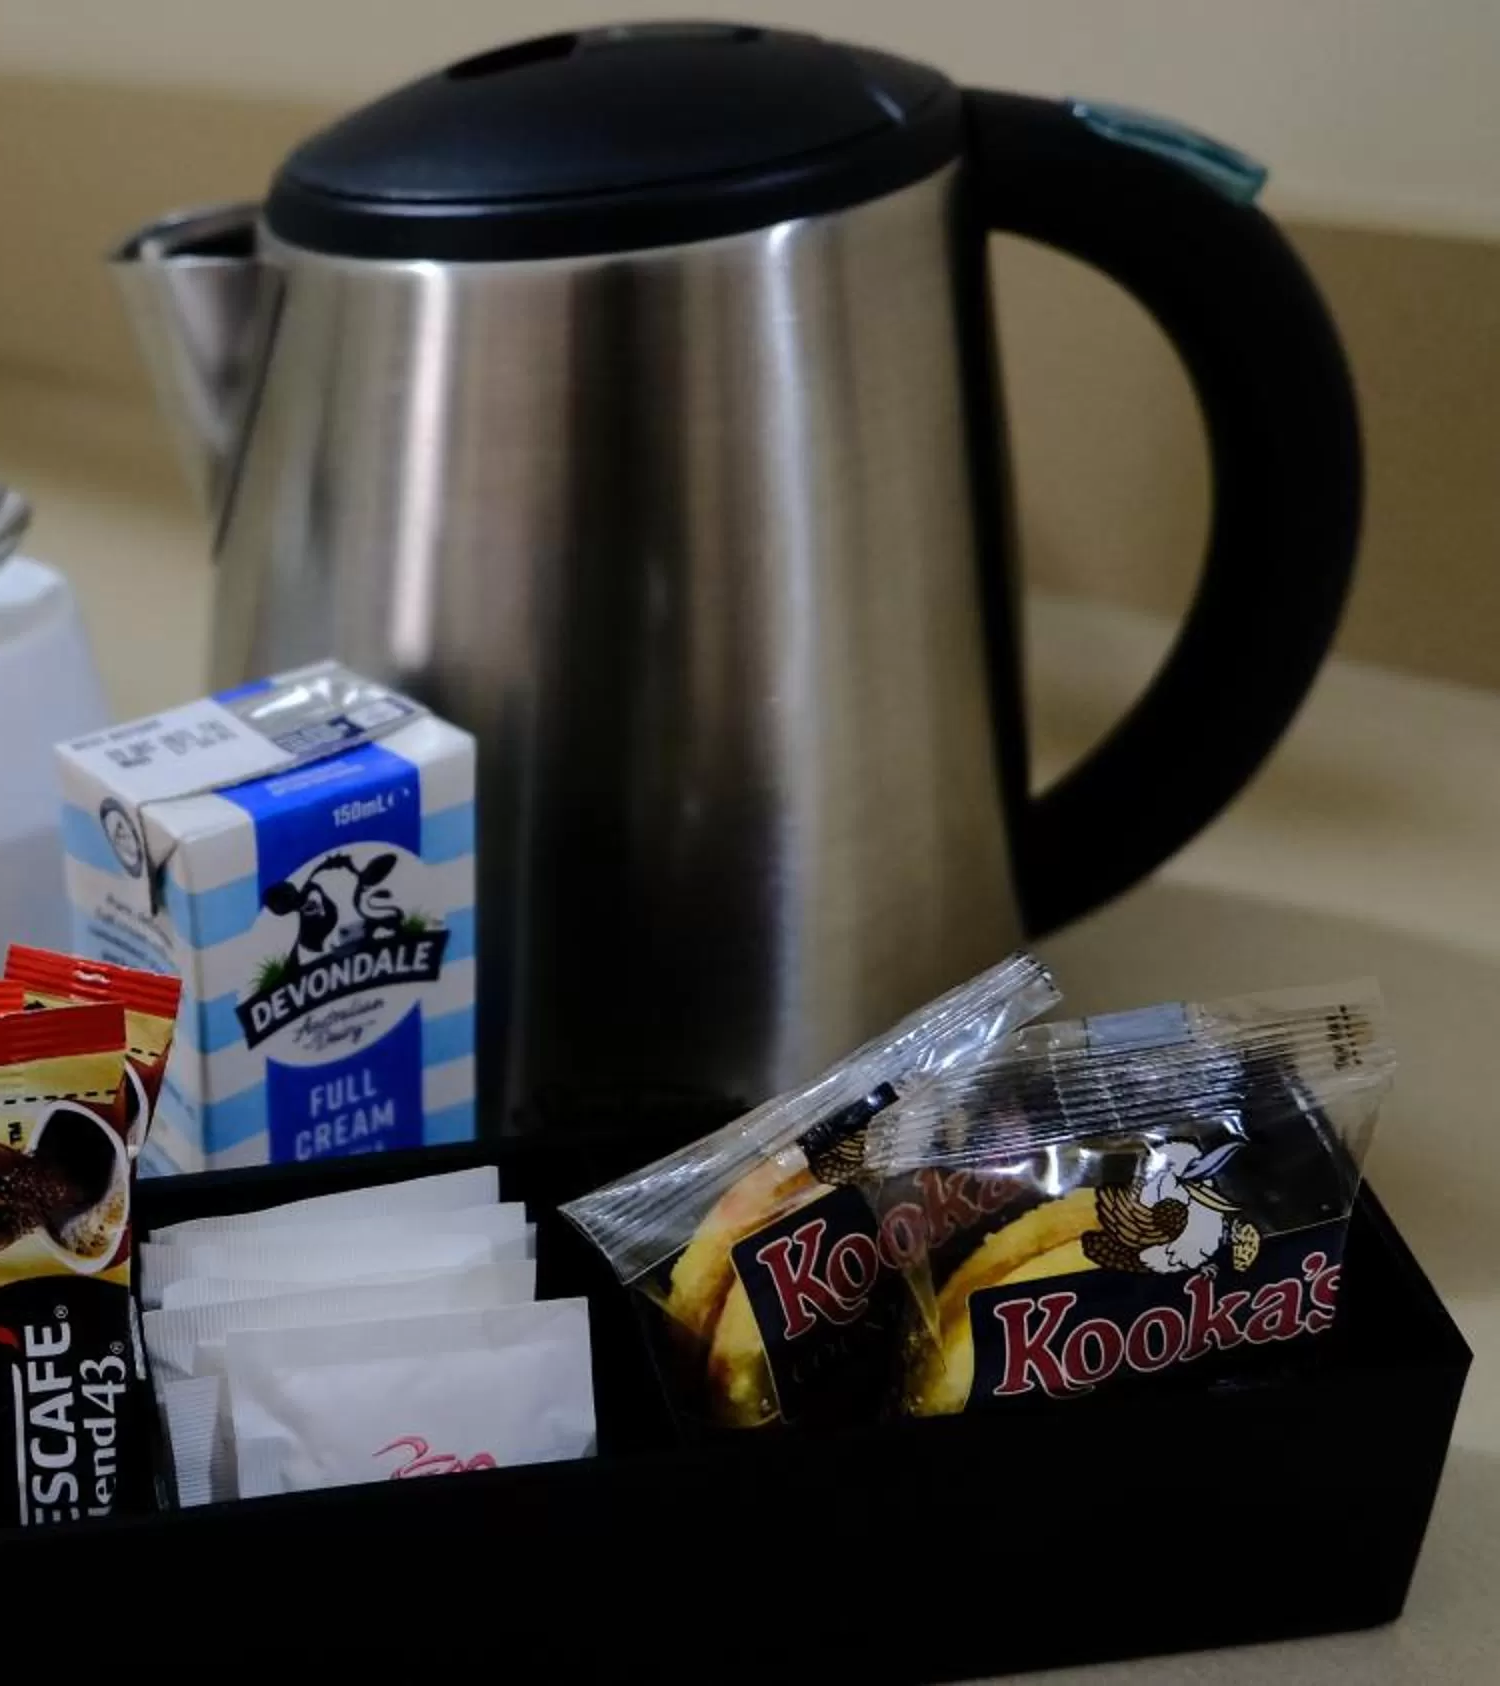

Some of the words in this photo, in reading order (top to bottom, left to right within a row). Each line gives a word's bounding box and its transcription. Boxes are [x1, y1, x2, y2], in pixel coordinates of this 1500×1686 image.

[251, 941, 434, 1033] DEVONDALE
[295, 1098, 395, 1162] CREAM
[309, 1067, 377, 1119] FULL
[756, 1168, 1022, 1341] Kooka
[993, 1251, 1343, 1400] Kooka's
